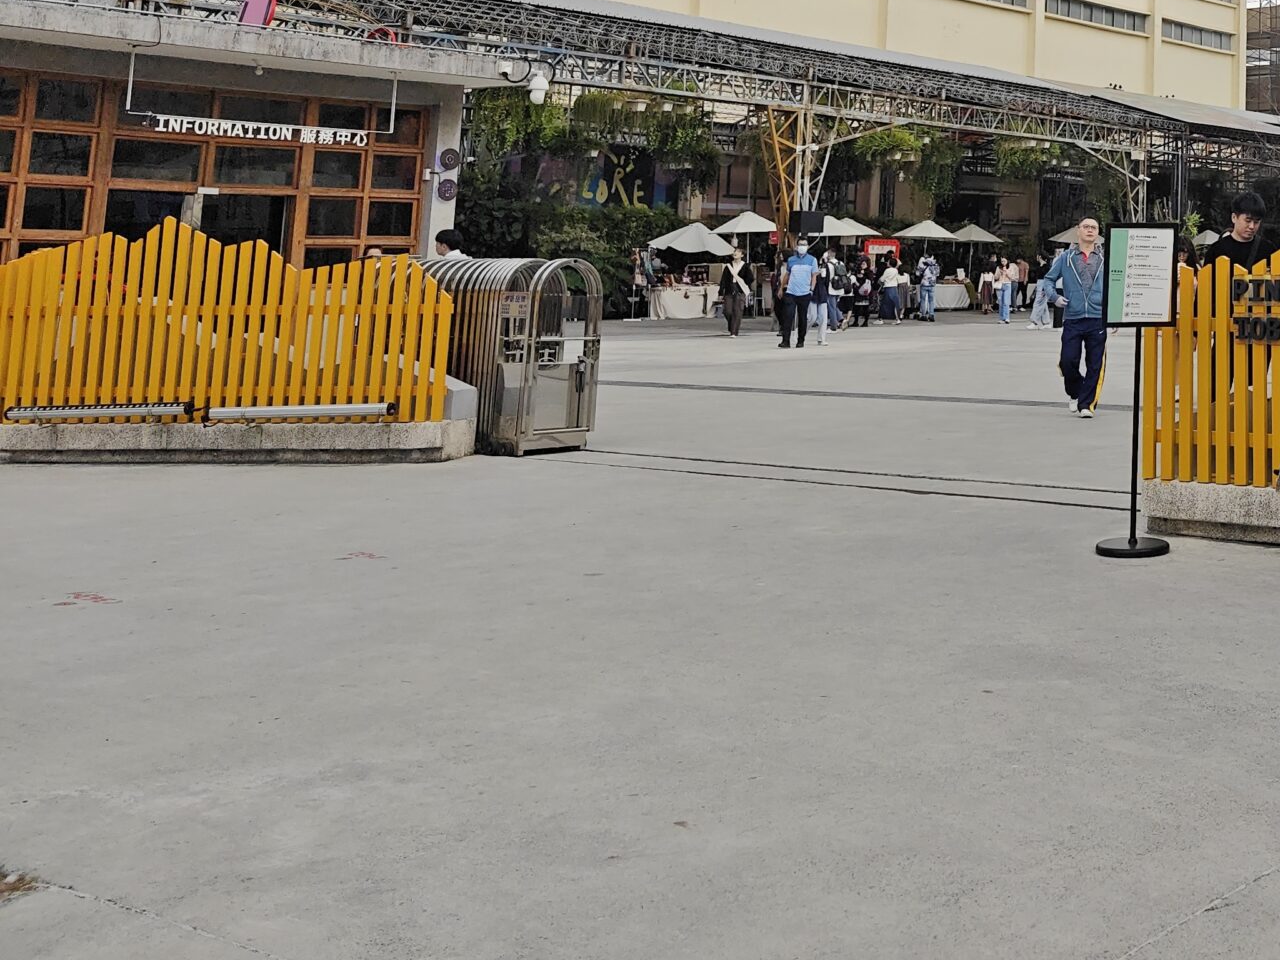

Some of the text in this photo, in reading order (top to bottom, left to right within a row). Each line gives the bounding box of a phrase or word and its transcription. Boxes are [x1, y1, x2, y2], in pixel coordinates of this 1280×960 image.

[154, 114, 368, 147] INFORMATION 服務中心
